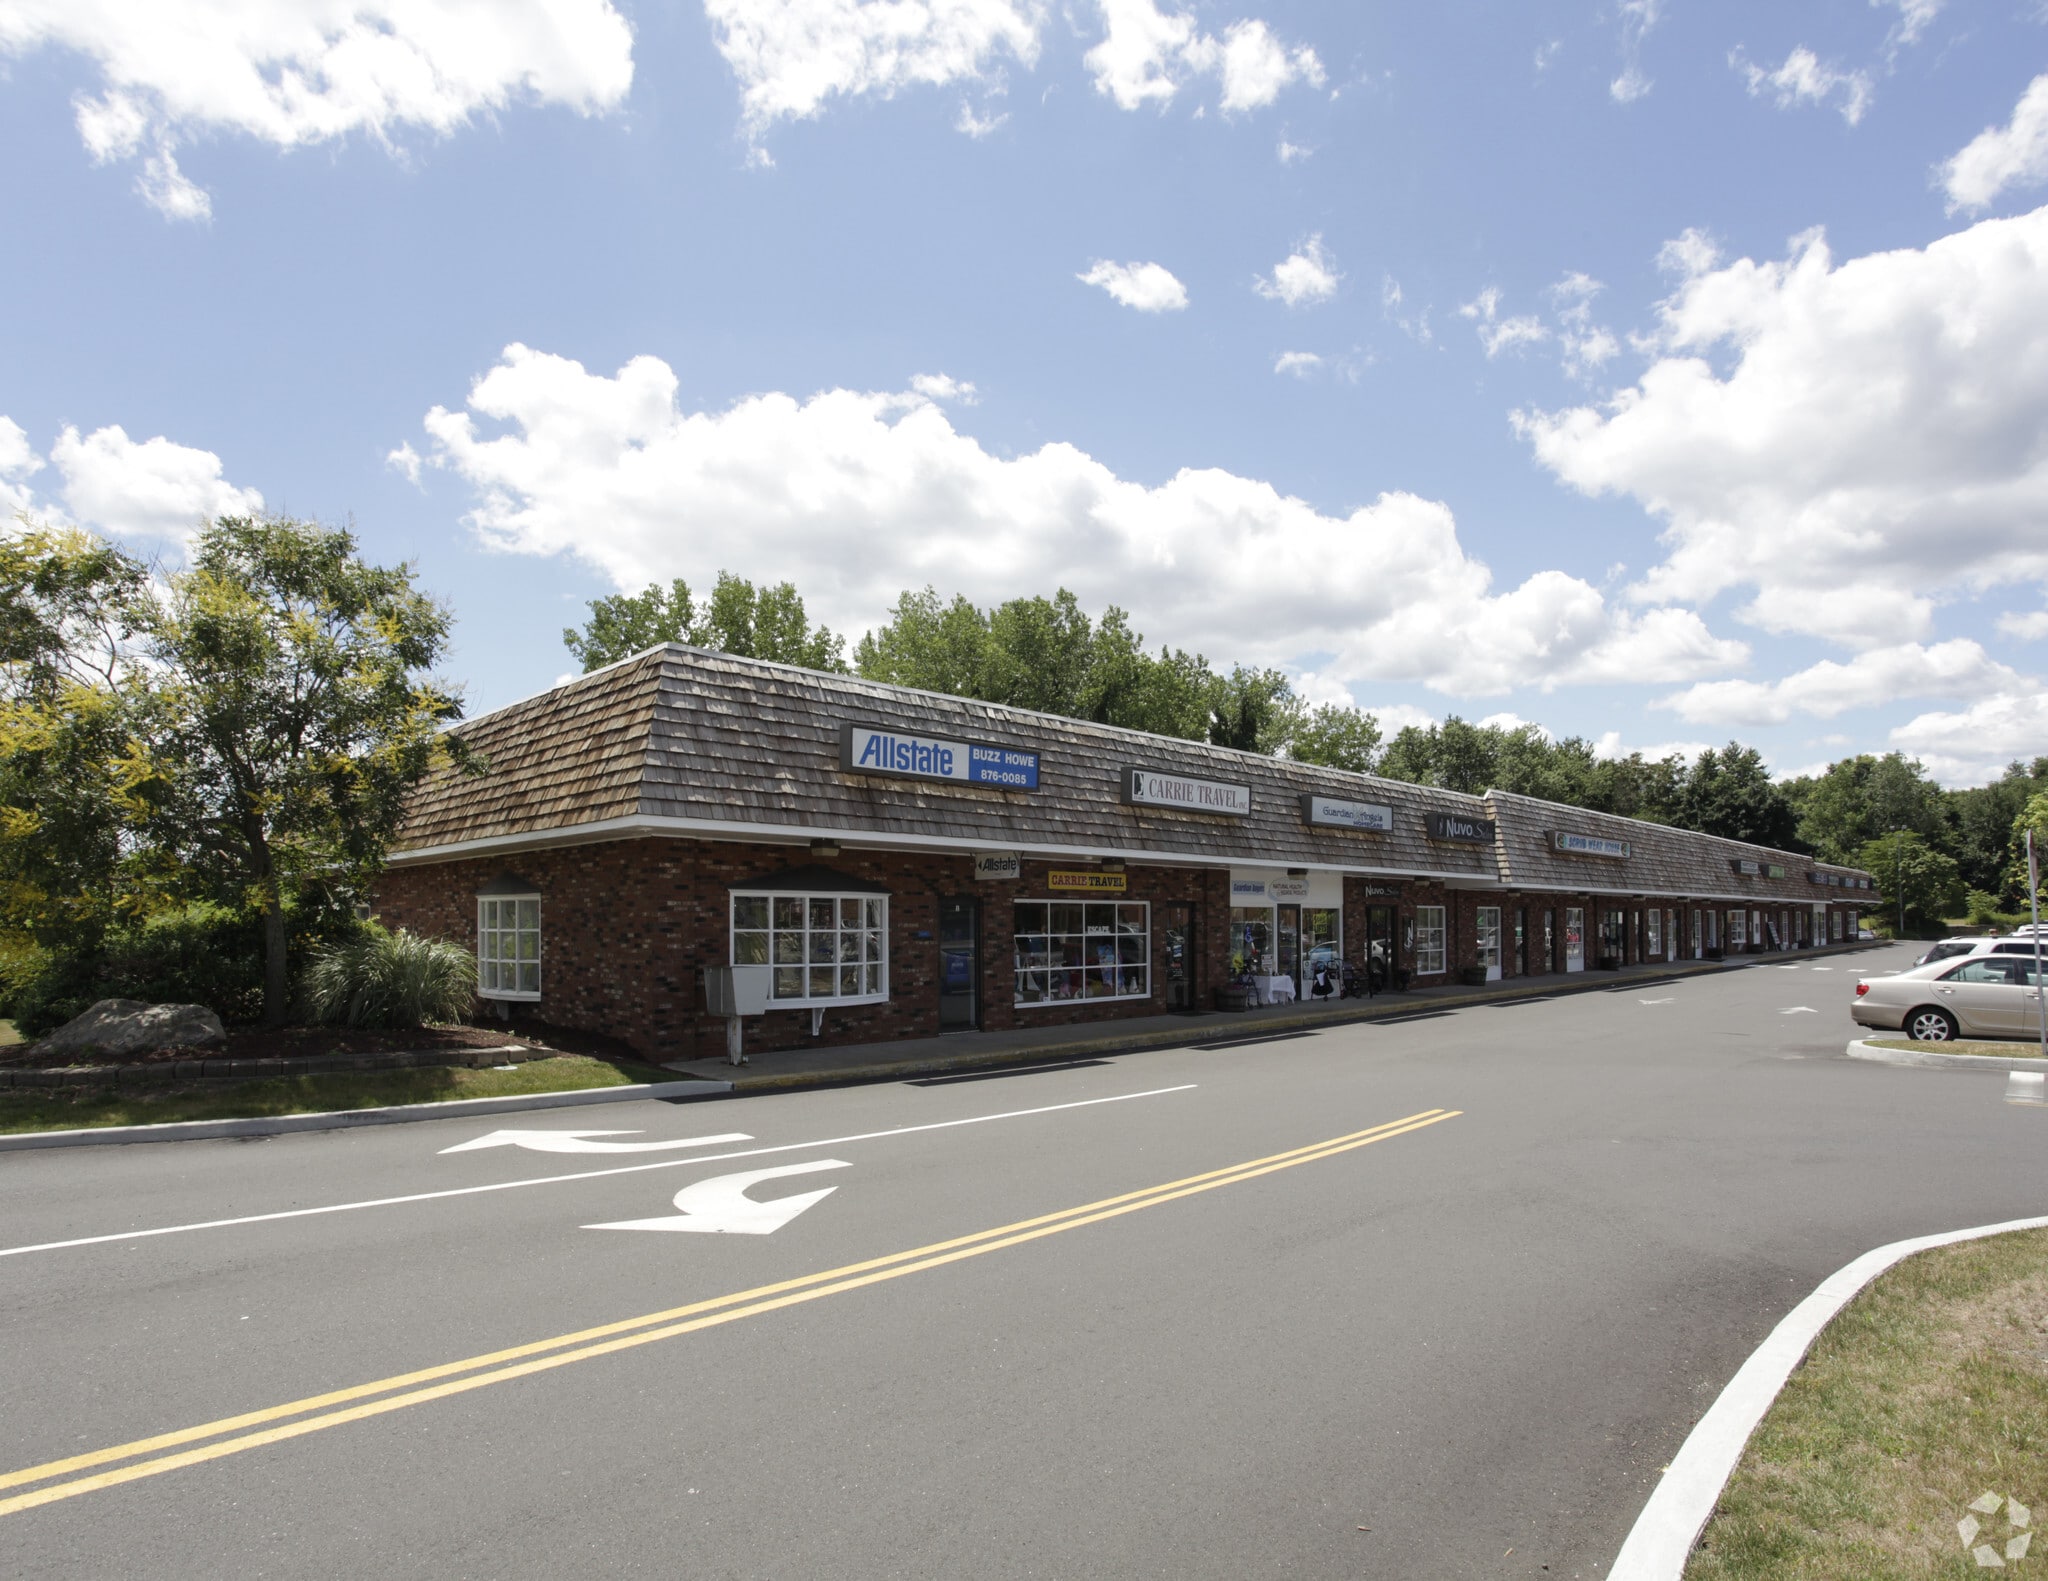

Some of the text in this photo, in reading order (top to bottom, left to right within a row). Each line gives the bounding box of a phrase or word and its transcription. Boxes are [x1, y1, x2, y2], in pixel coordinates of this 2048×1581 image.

[859, 734, 954, 776] Allstate
[972, 748, 1035, 767] BUZZ HOWE
[980, 769, 1027, 785] 876-0085
[1149, 778, 1194, 803] CARRIE
[1197, 785, 1239, 808] TRAVEL
[1322, 806, 1354, 819] Guardian
[982, 857, 1017, 872] Allstate
[1051, 874, 1125, 887] CARRIE TRAVEL
[1365, 884, 1385, 898] Nuvo
